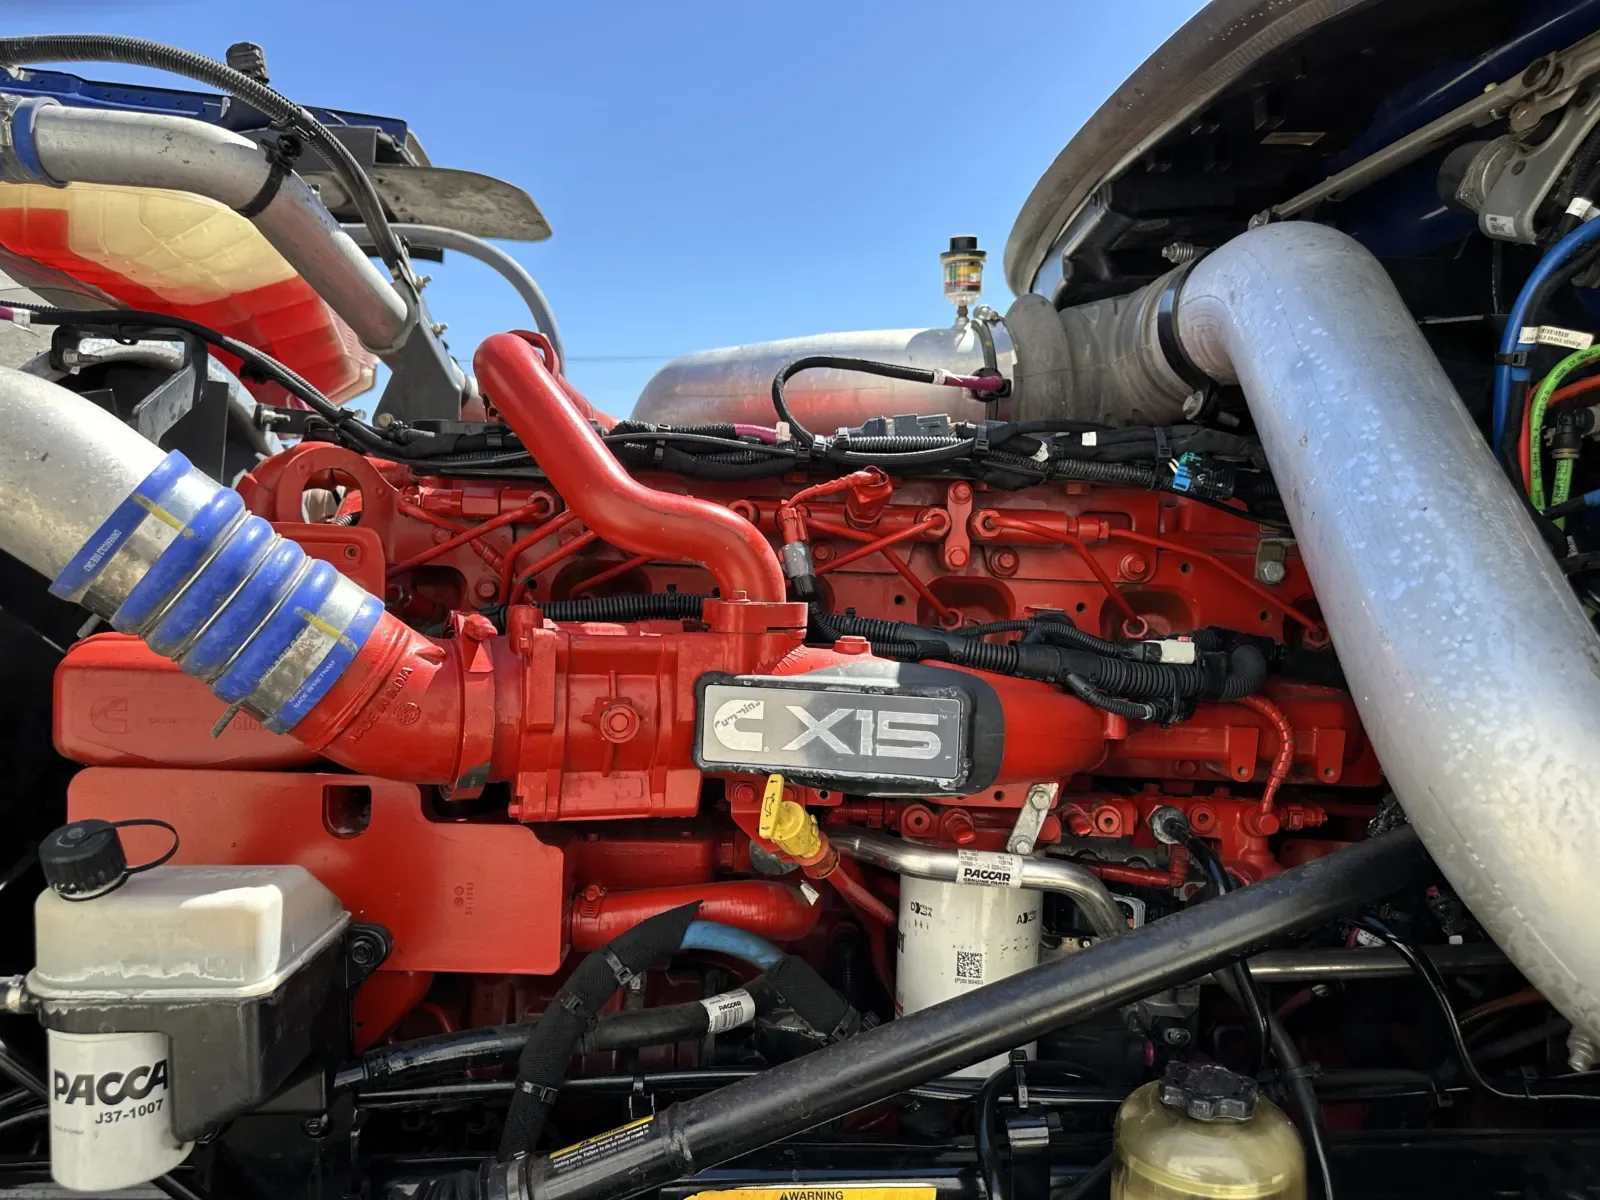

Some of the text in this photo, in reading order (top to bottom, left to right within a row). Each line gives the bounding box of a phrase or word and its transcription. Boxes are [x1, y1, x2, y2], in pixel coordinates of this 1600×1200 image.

[293, 693, 308, 709] MADE
[312, 660, 336, 687] VIETNAM
[388, 666, 413, 700] INDIA
[781, 705, 941, 759] X15
[964, 868, 1011, 881] PACCAR
[718, 1001, 741, 1010] PACCAR
[54, 1059, 168, 1105] PACCA
[95, 1098, 164, 1124] J37-1007
[583, 1148, 598, 1157] Failure
[789, 1190, 843, 1200] WARNING
